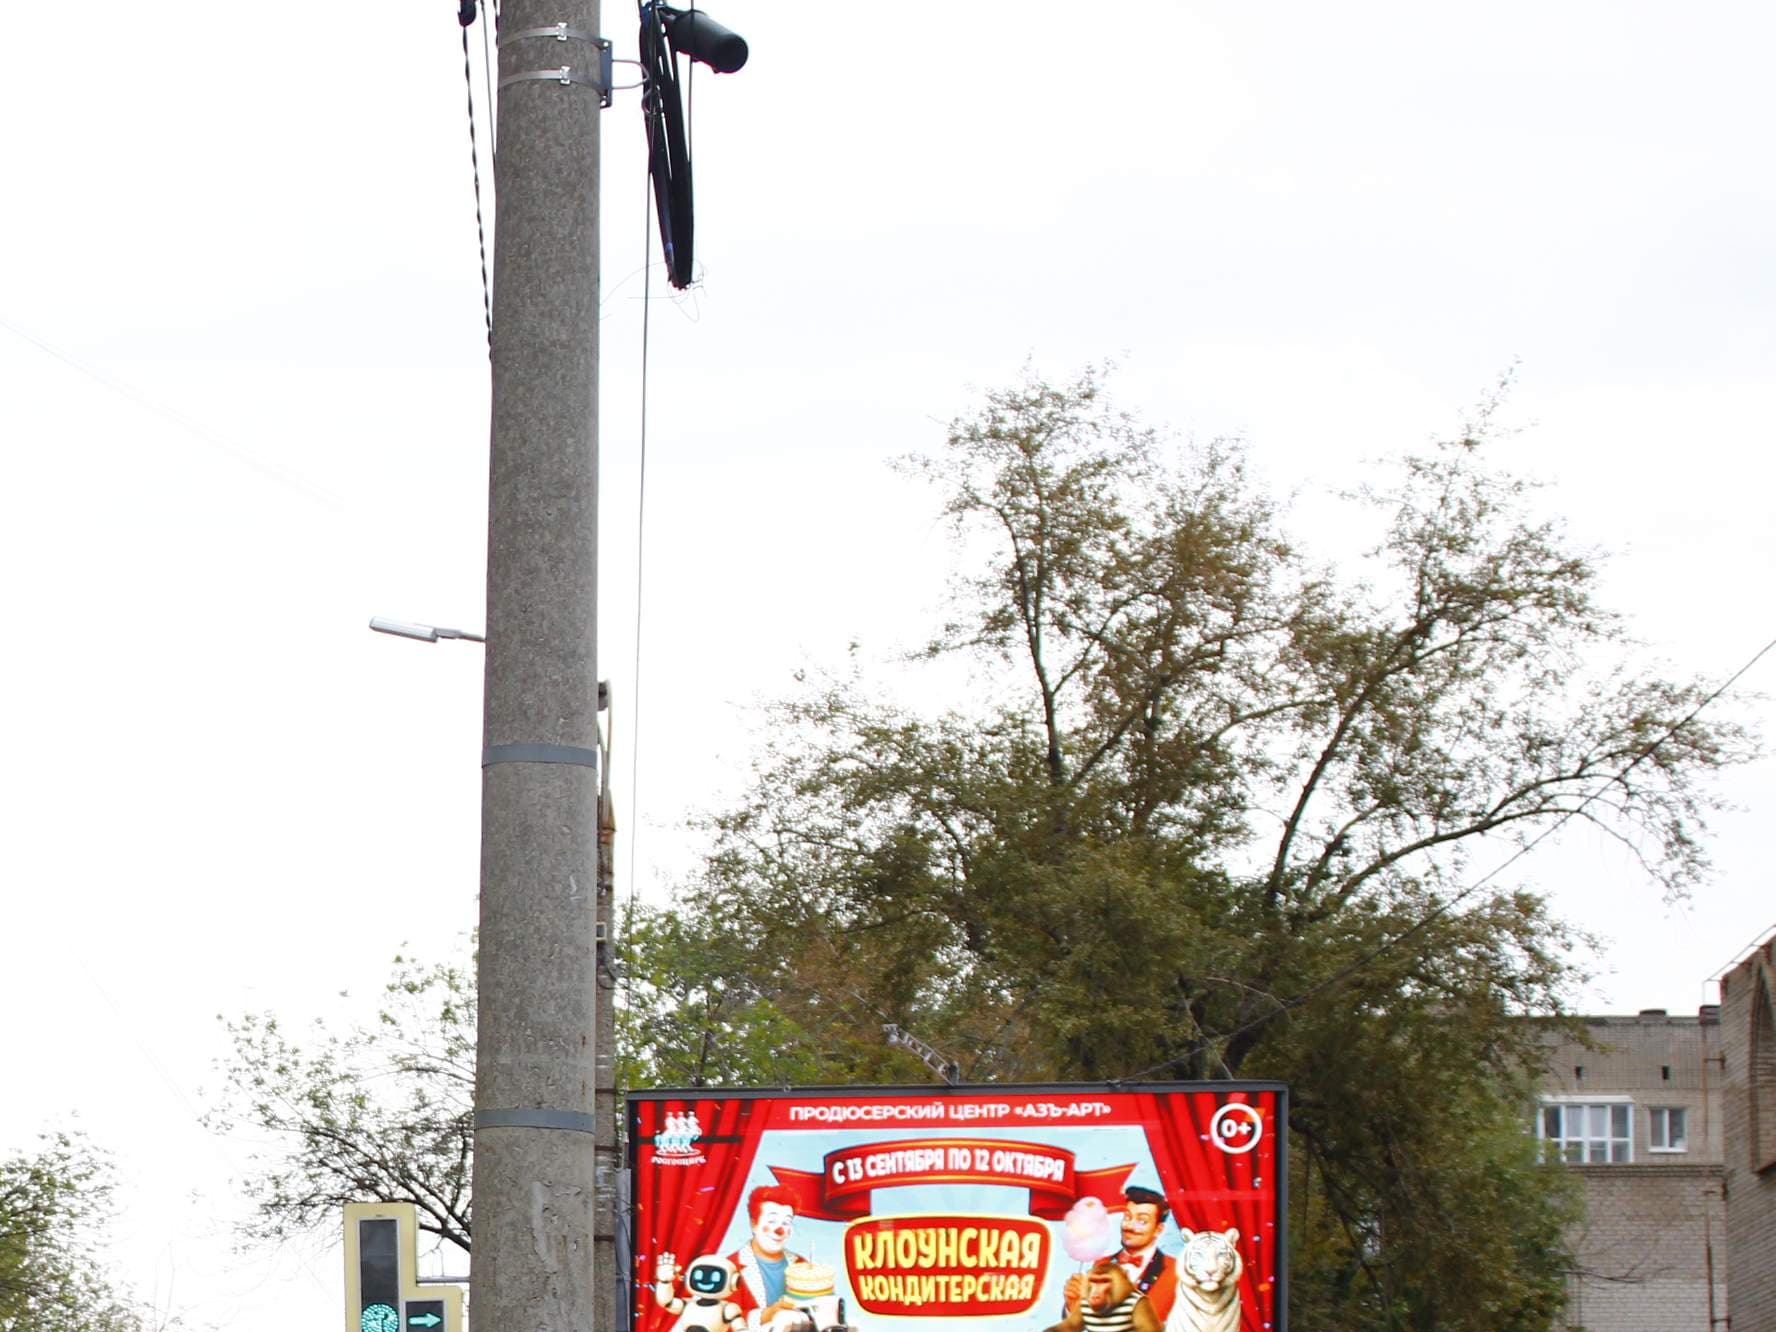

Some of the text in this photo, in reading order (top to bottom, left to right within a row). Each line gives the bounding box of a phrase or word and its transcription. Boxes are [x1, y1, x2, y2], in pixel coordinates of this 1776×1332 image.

[789, 1101, 1112, 1122] ПРОДЮСЕРСКИЙ ЦЕНТР «АЗЪ-АРТ»
[1220, 1118, 1252, 1138] 0+
[832, 1147, 1066, 1185] С 13 СЕНТЯБРЯ ПО 12 ОКТЯБРЯ
[853, 1226, 1042, 1270] КЛОУНСКАЯ
[857, 1273, 1036, 1307] КОНДИТЕРСКАЯ
